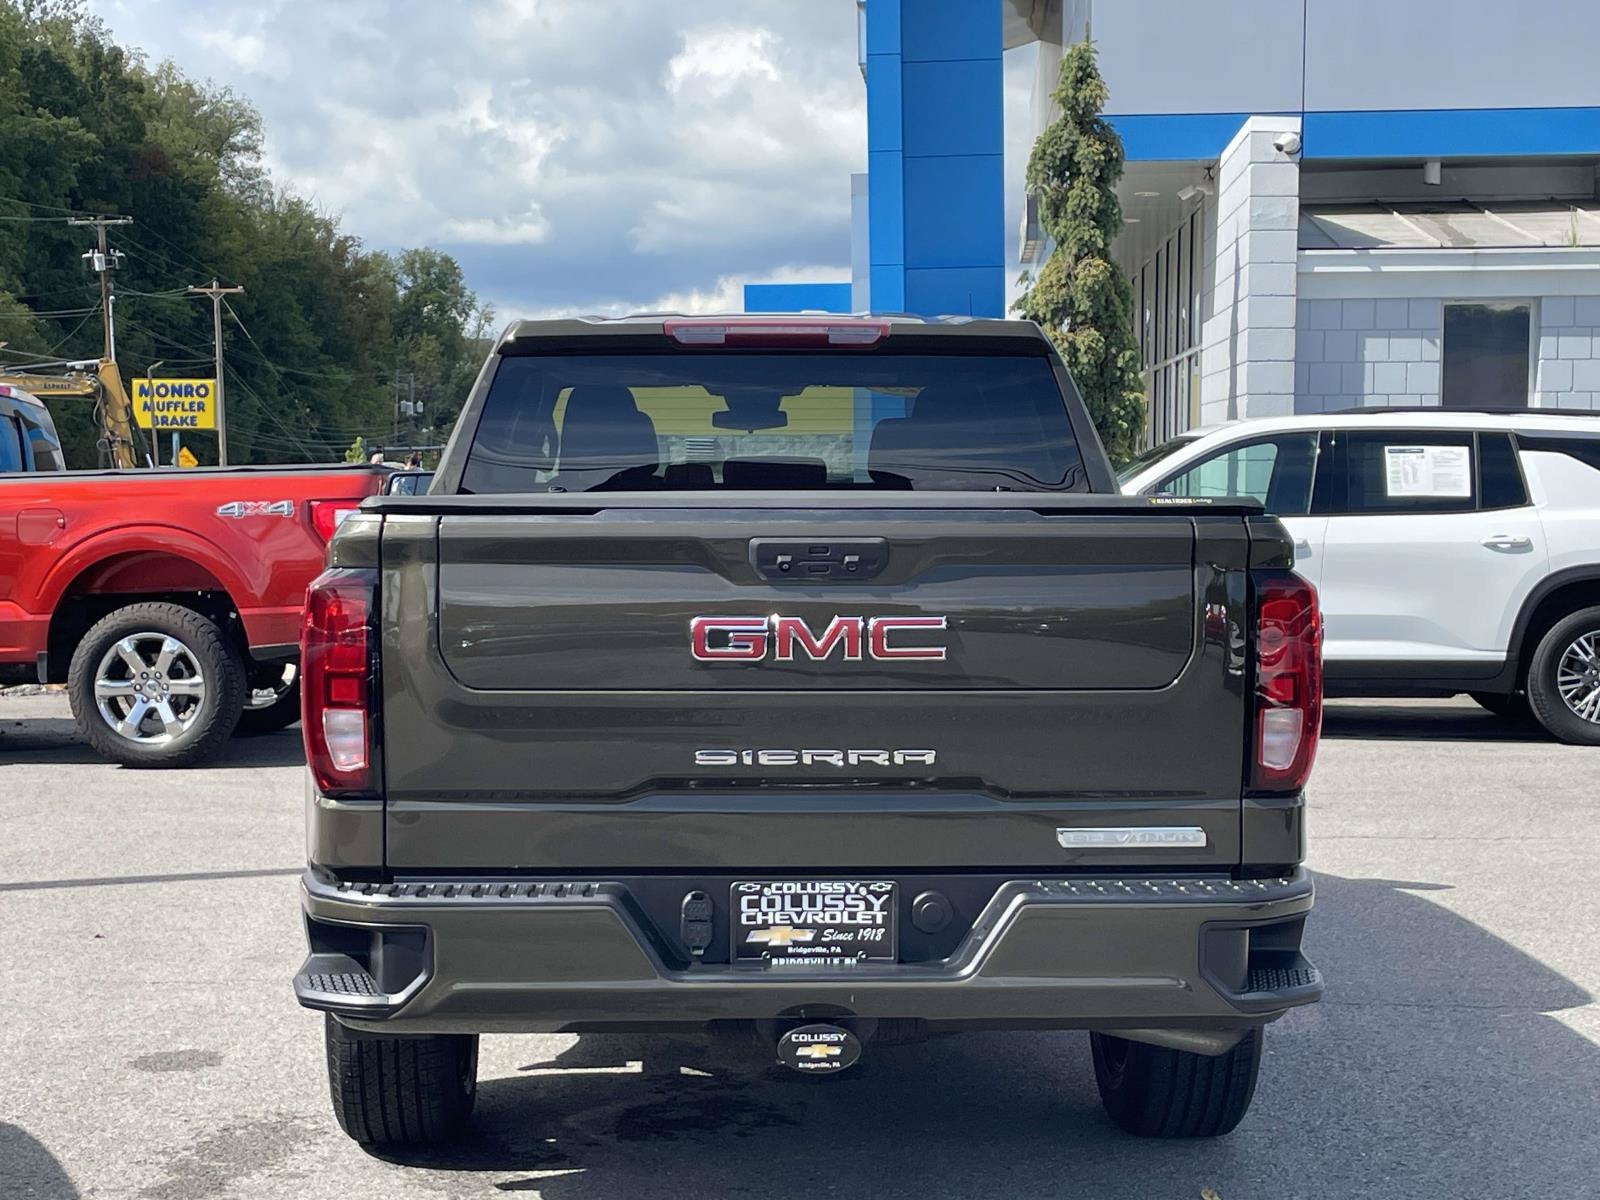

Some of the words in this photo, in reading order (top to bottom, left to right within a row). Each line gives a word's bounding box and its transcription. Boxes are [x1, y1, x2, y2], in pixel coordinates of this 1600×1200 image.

[138, 382, 209, 398] MONRO
[142, 400, 206, 412] MUFFLER
[690, 614, 947, 662] GMC
[694, 749, 937, 766] SIERRA
[771, 882, 860, 894] COLUSSY
[740, 894, 890, 912] COLUSSY
[740, 911, 888, 925] CHEVROLET
[821, 928, 854, 942] Since
[857, 928, 886, 942] 1918
[791, 1033, 847, 1042] COLUSSY
